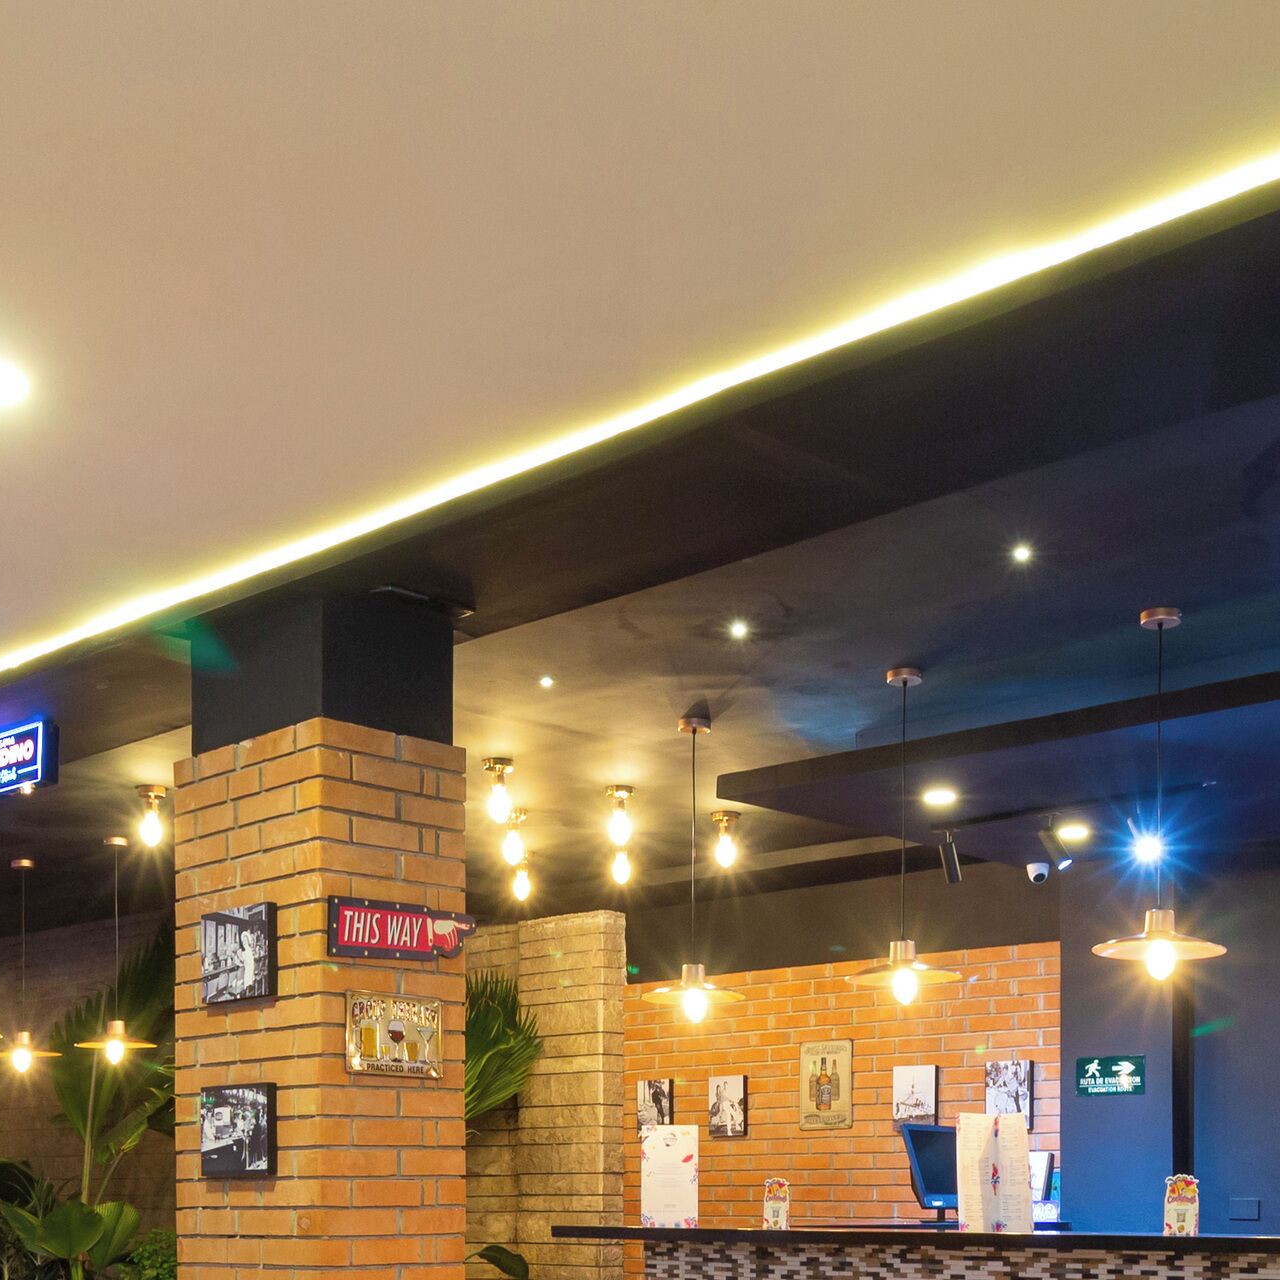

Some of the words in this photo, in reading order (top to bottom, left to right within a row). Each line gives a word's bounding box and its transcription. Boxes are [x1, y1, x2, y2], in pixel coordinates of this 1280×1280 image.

[344, 910, 381, 945] THIS
[387, 914, 423, 948] WAY
[366, 1062, 404, 1073] PRACTICED
[407, 1064, 424, 1074] HERE
